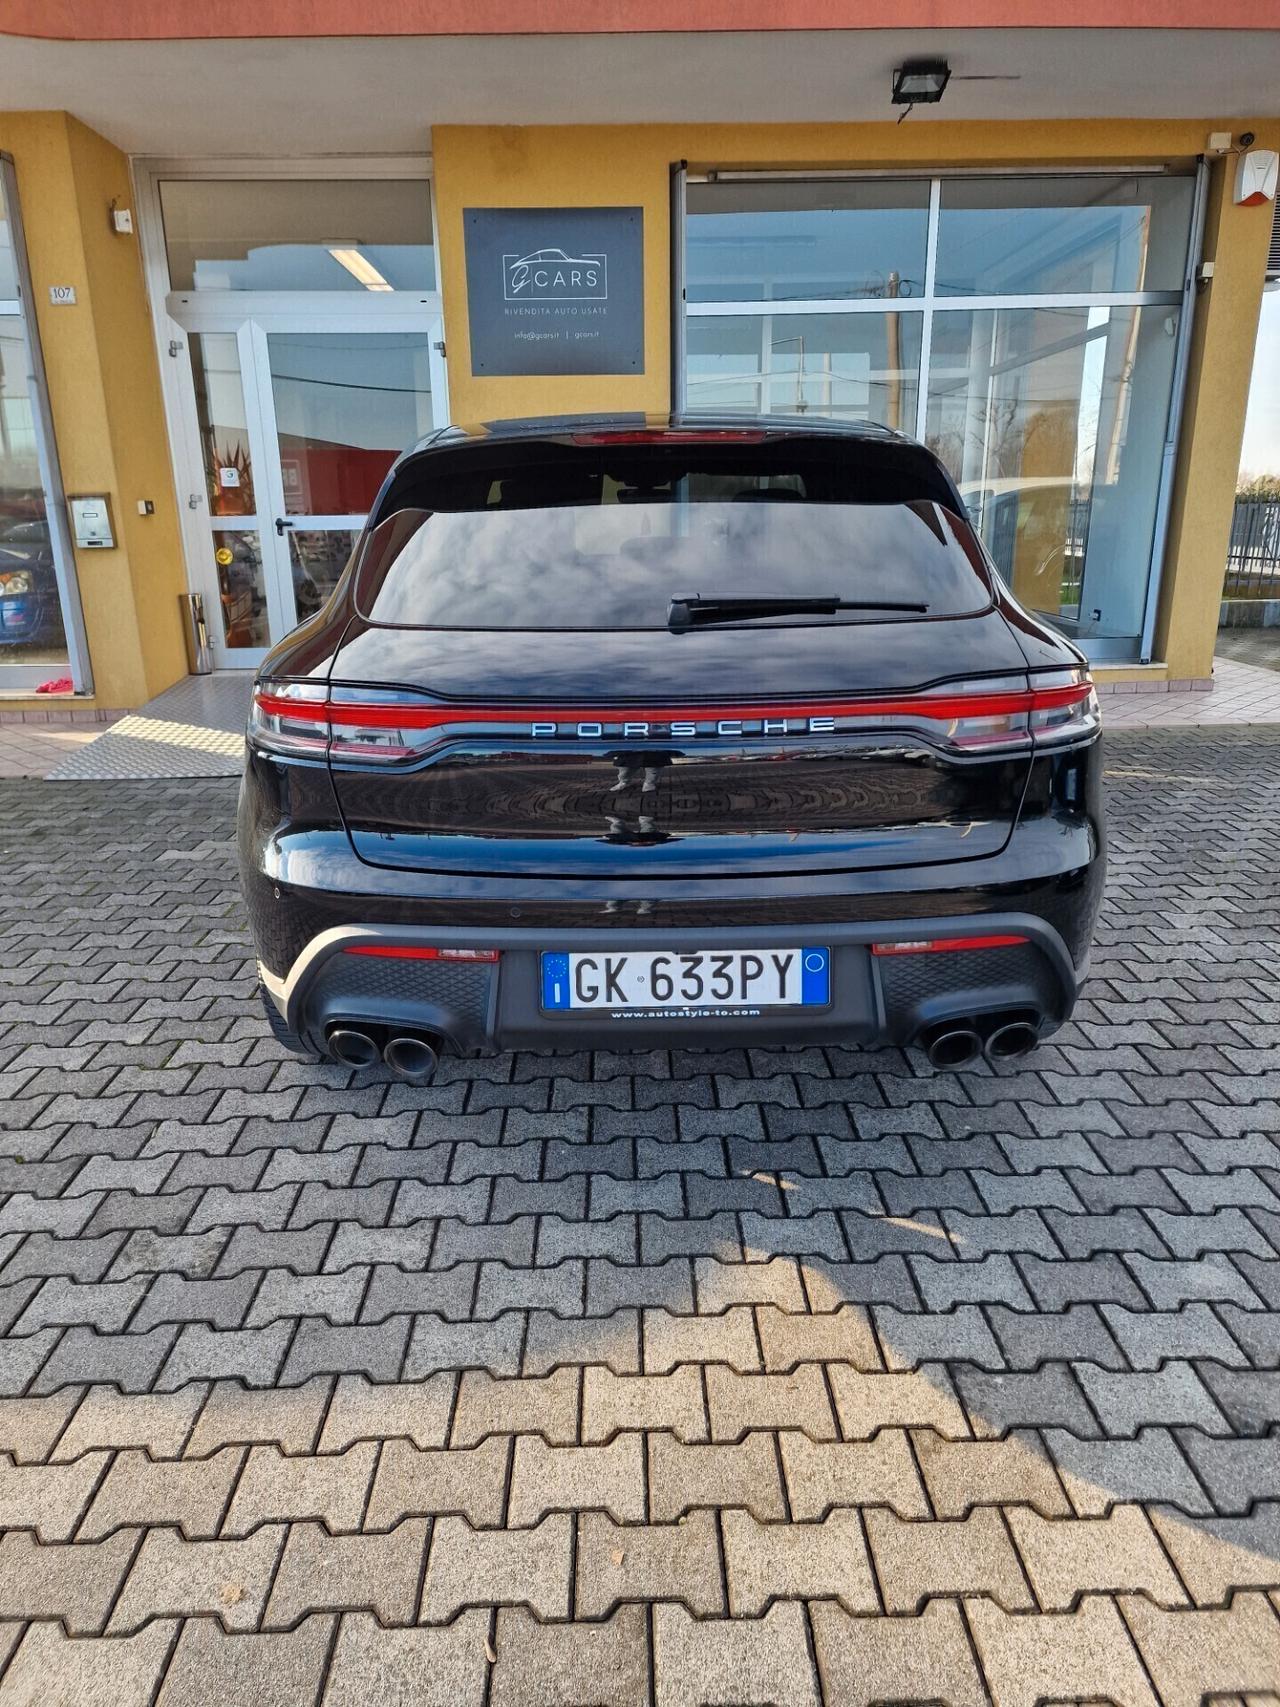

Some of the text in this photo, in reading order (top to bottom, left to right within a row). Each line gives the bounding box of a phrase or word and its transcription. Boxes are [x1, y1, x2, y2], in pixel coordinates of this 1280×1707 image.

[534, 270, 597, 287] CARS
[53, 287, 71, 299] 107
[504, 307, 607, 316] RIVENDITA AUTO USATE
[531, 717, 835, 737] PORSCHE
[575, 956, 629, 1003] GK
[650, 953, 794, 1002] 633PY
[611, 1009, 760, 1018] www.autostyle-to.com
